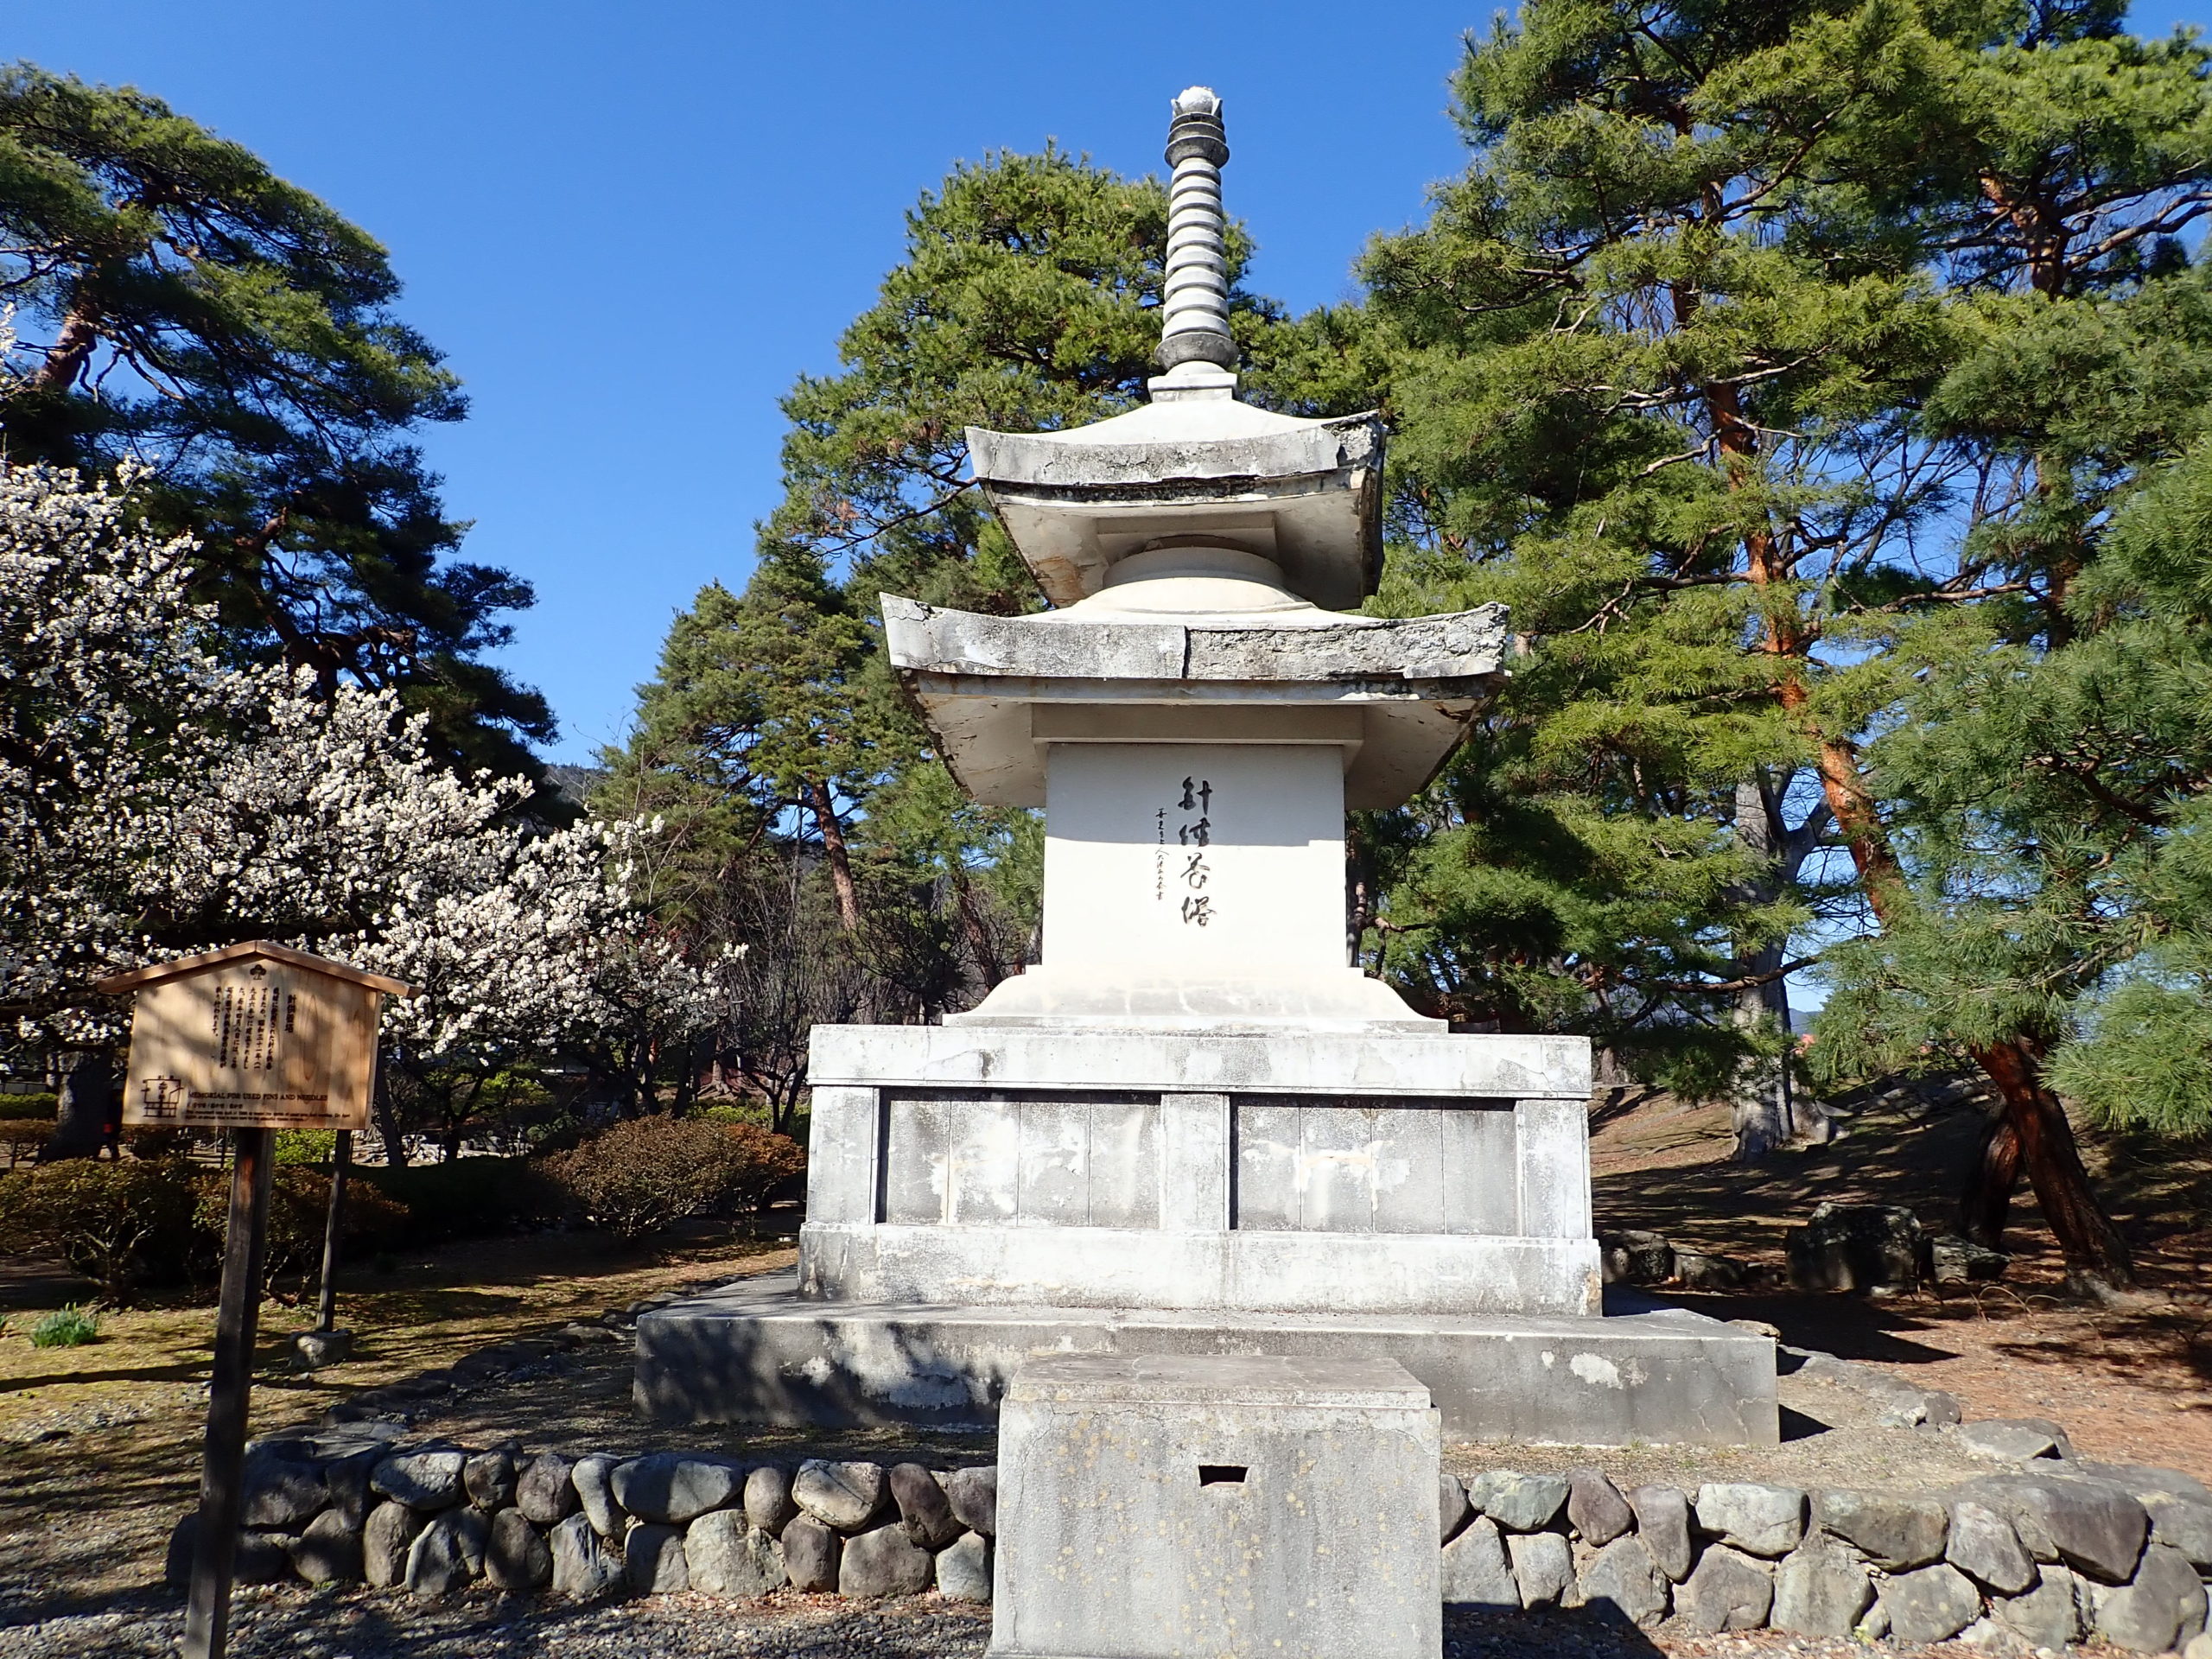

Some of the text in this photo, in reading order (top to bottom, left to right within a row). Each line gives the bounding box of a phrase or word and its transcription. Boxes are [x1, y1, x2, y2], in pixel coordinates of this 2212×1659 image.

[1178, 776, 1217, 926] 針供養塔
[284, 995, 296, 1033] 針供養塔
